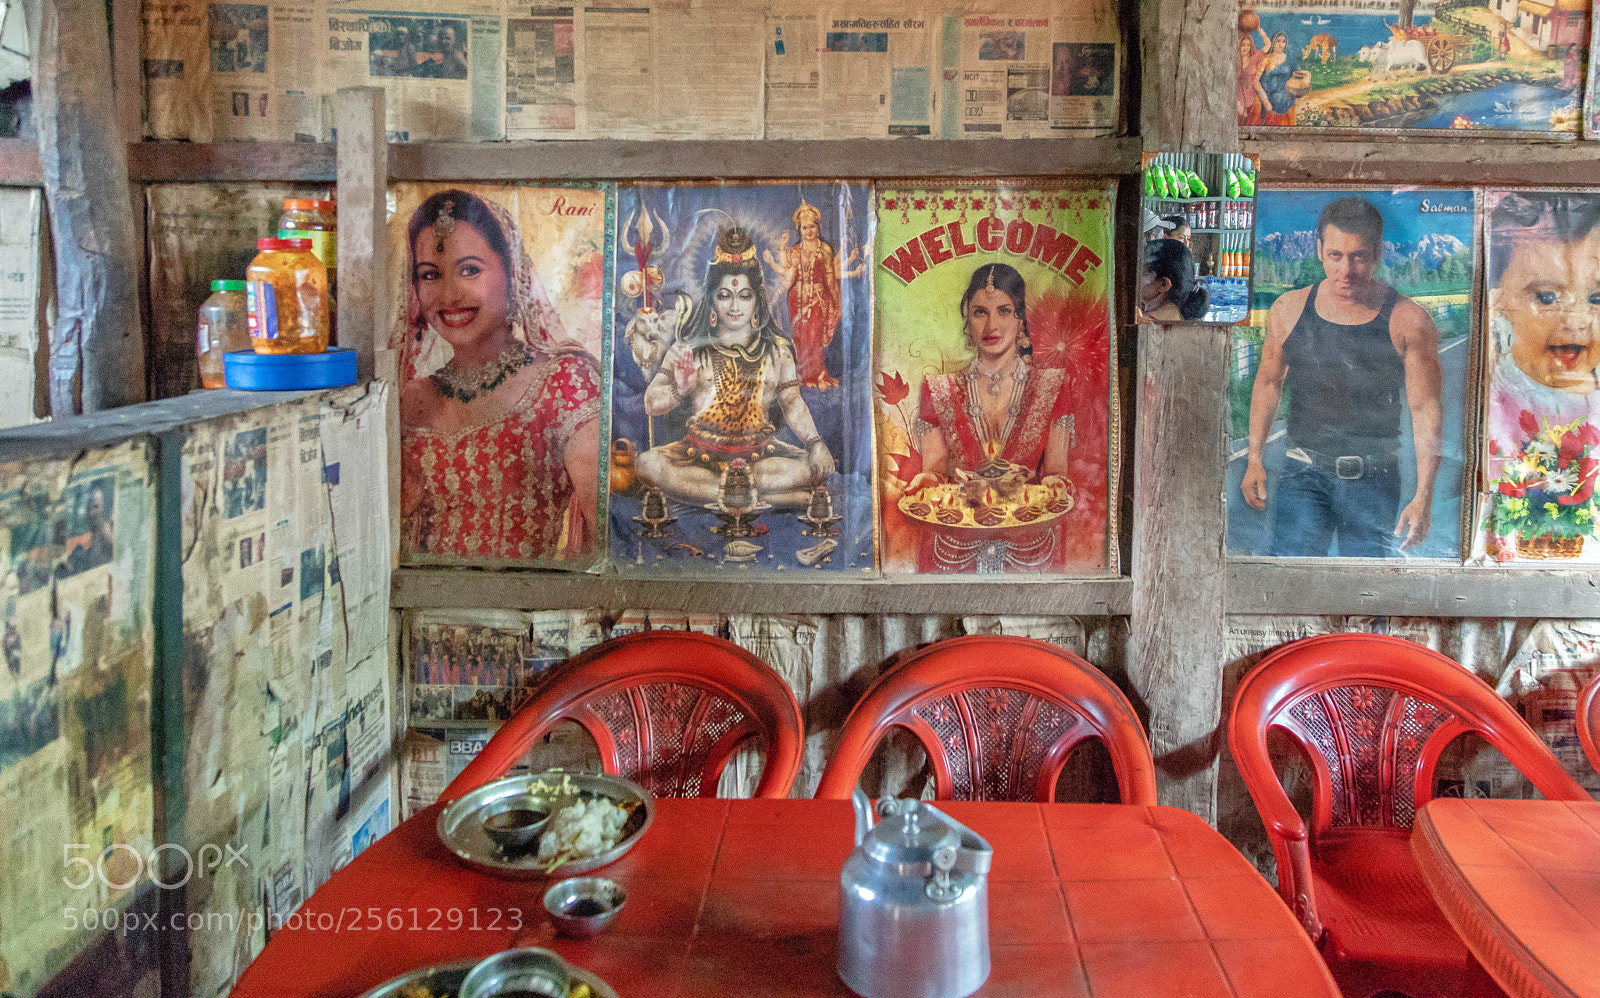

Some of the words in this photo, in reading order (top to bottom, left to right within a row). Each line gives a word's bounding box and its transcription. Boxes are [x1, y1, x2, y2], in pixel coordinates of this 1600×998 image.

[538, 195, 597, 217] Rani
[1420, 198, 1468, 213] Salman
[881, 216, 1104, 286] WELCOME
[1229, 627, 1239, 635] An
[1240, 629, 1267, 638] uneasy
[449, 741, 484, 754] BBA
